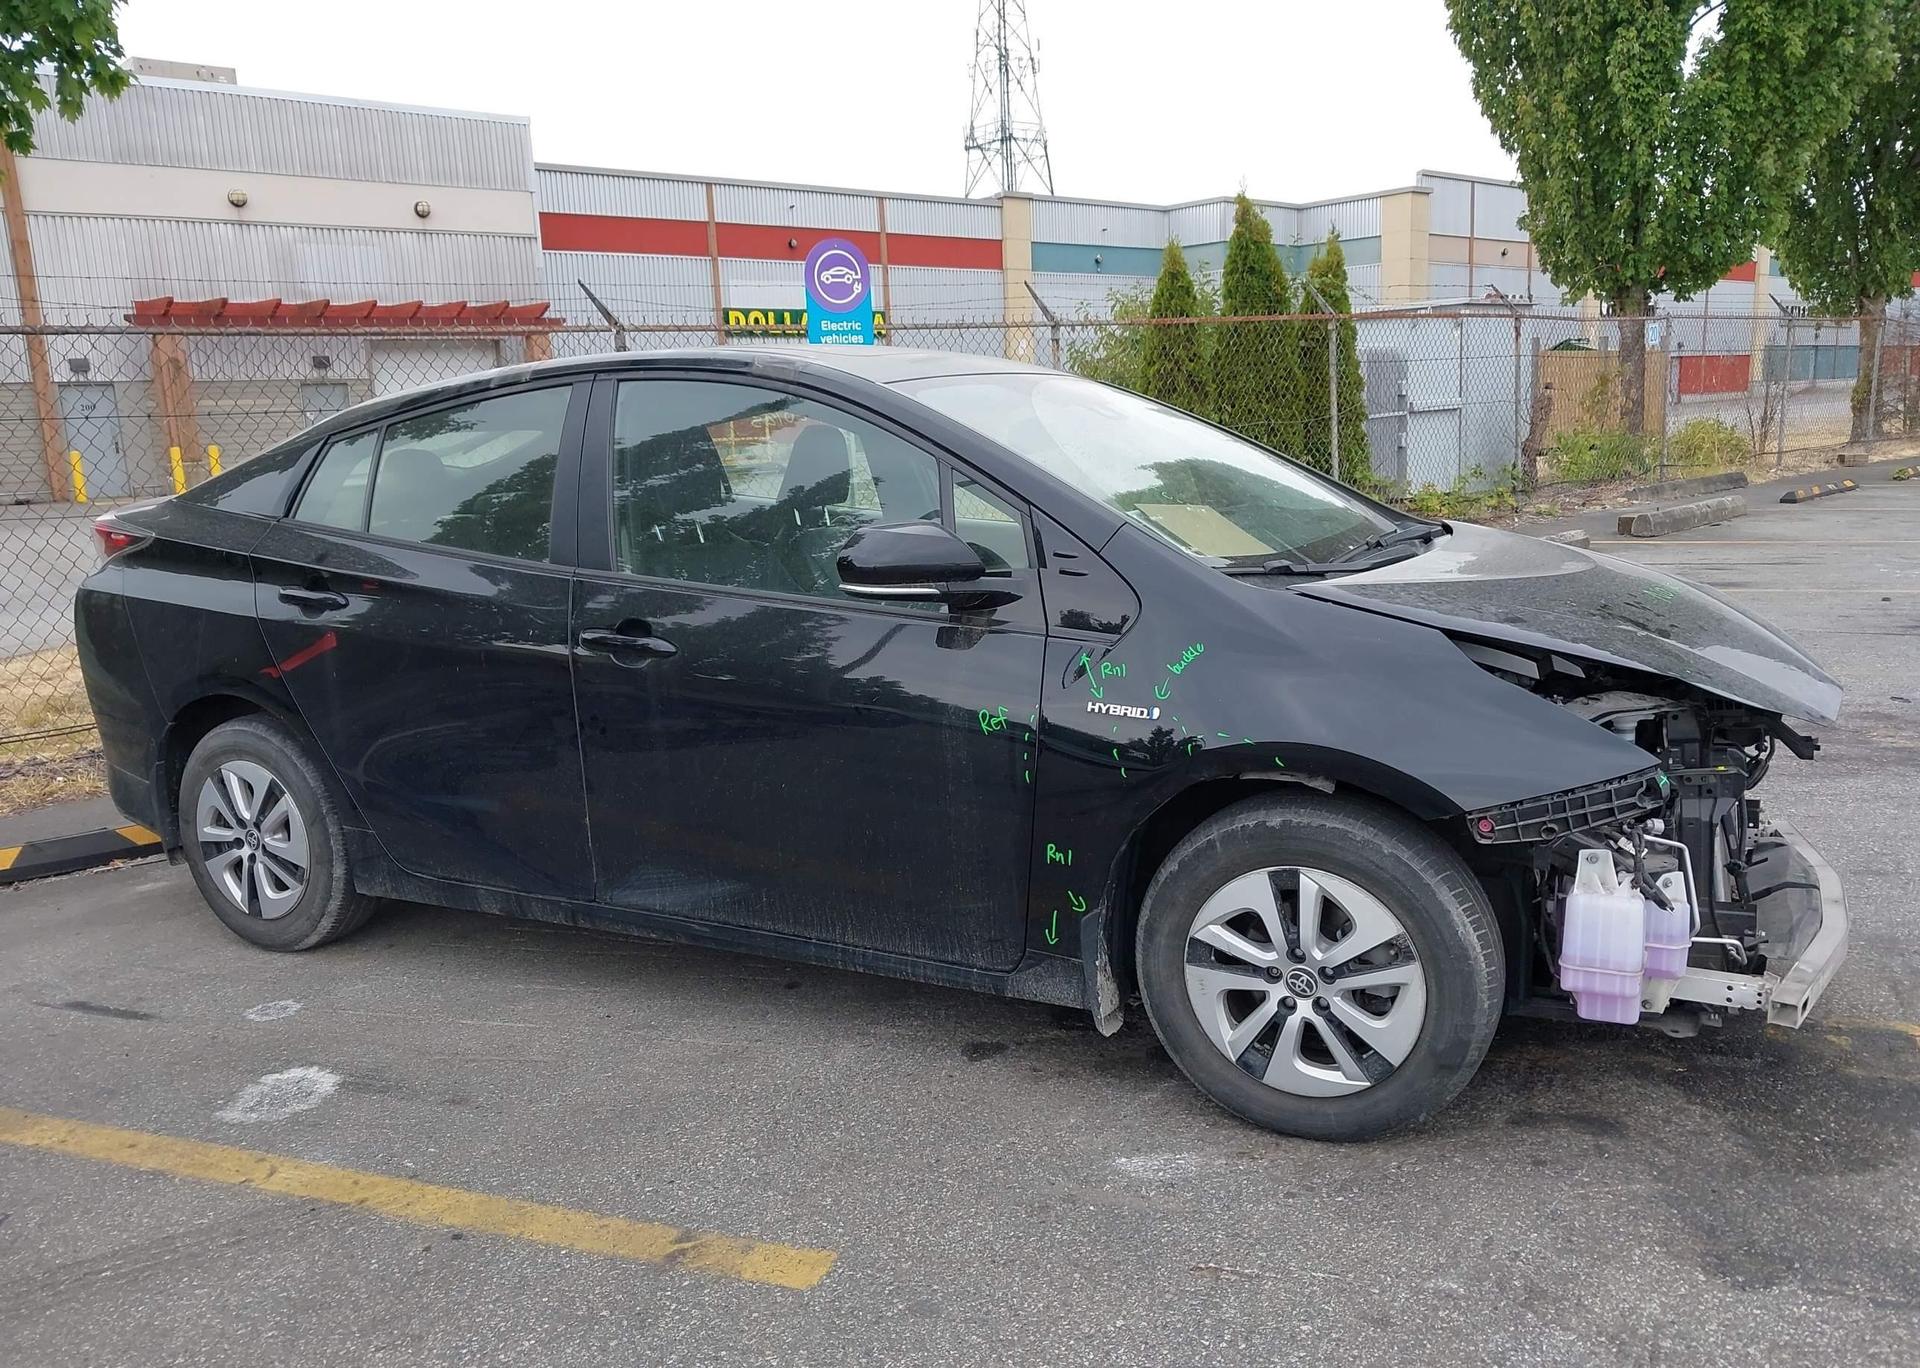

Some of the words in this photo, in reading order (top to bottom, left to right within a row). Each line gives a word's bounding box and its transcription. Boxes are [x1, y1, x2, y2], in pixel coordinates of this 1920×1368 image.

[820, 320, 862, 331] Electric
[820, 333, 864, 344] vehicles
[1086, 701, 1150, 719] HYBRID
